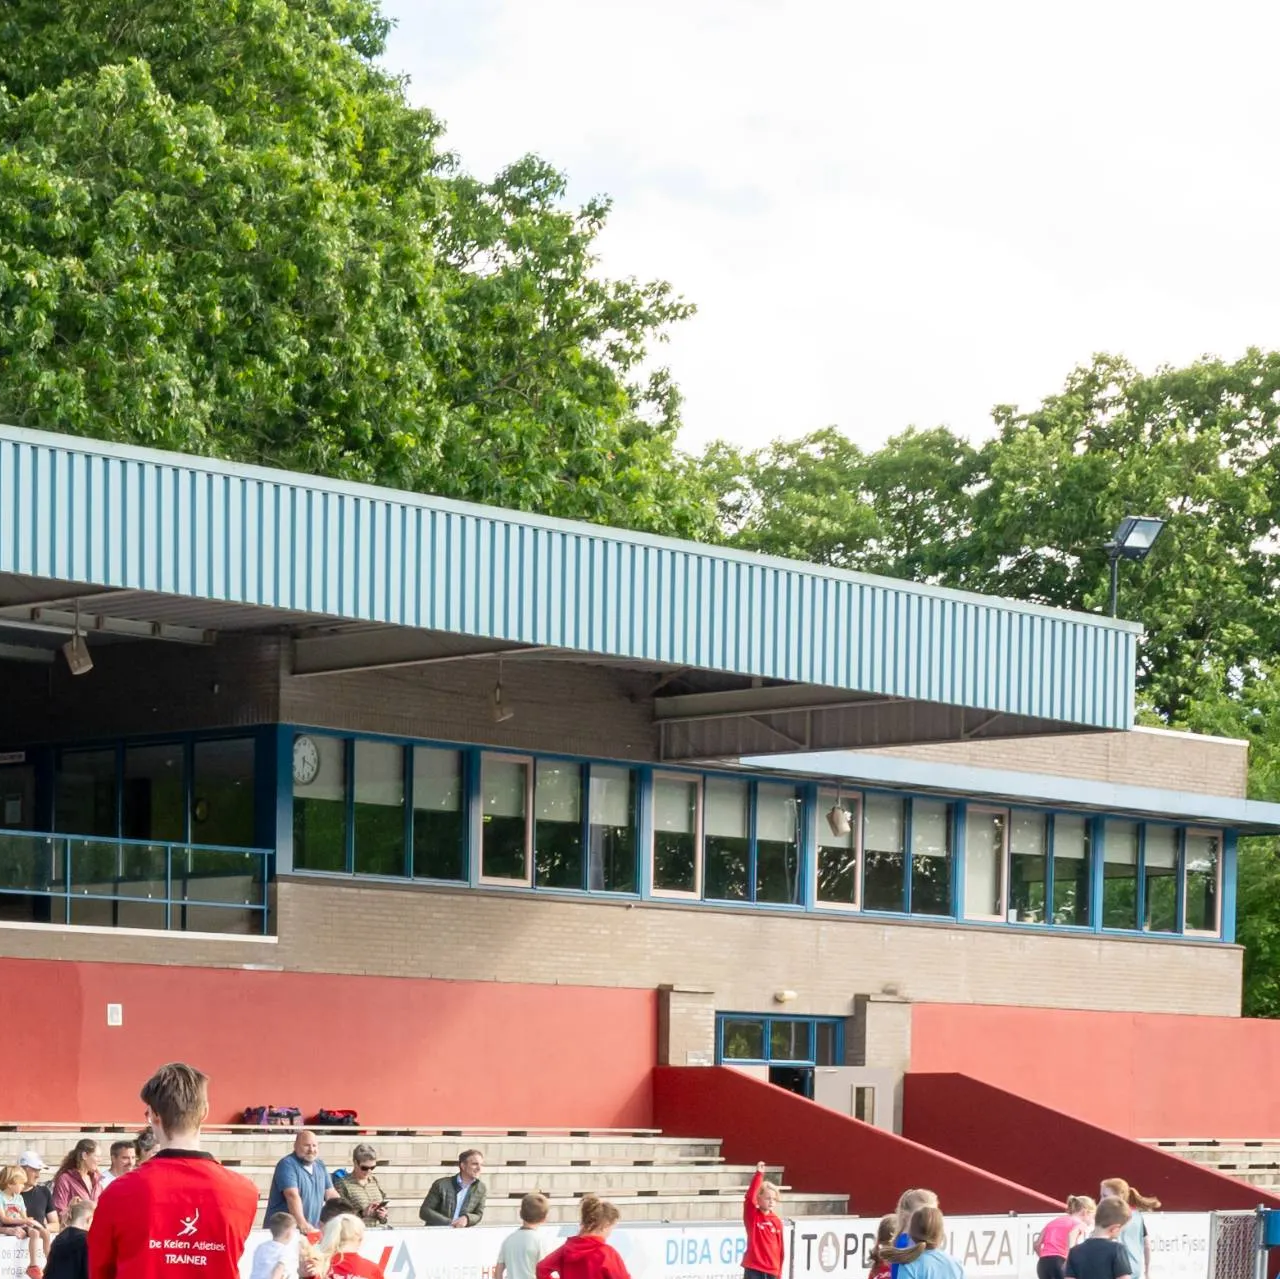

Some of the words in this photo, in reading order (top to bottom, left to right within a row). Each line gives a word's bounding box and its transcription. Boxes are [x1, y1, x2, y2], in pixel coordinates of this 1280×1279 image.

[148, 1239, 162, 1249] De
[163, 1239, 190, 1249] Keien
[191, 1240, 226, 1251] Atletiek
[665, 1237, 712, 1266] DIBA
[165, 1254, 207, 1265] TRAINER
